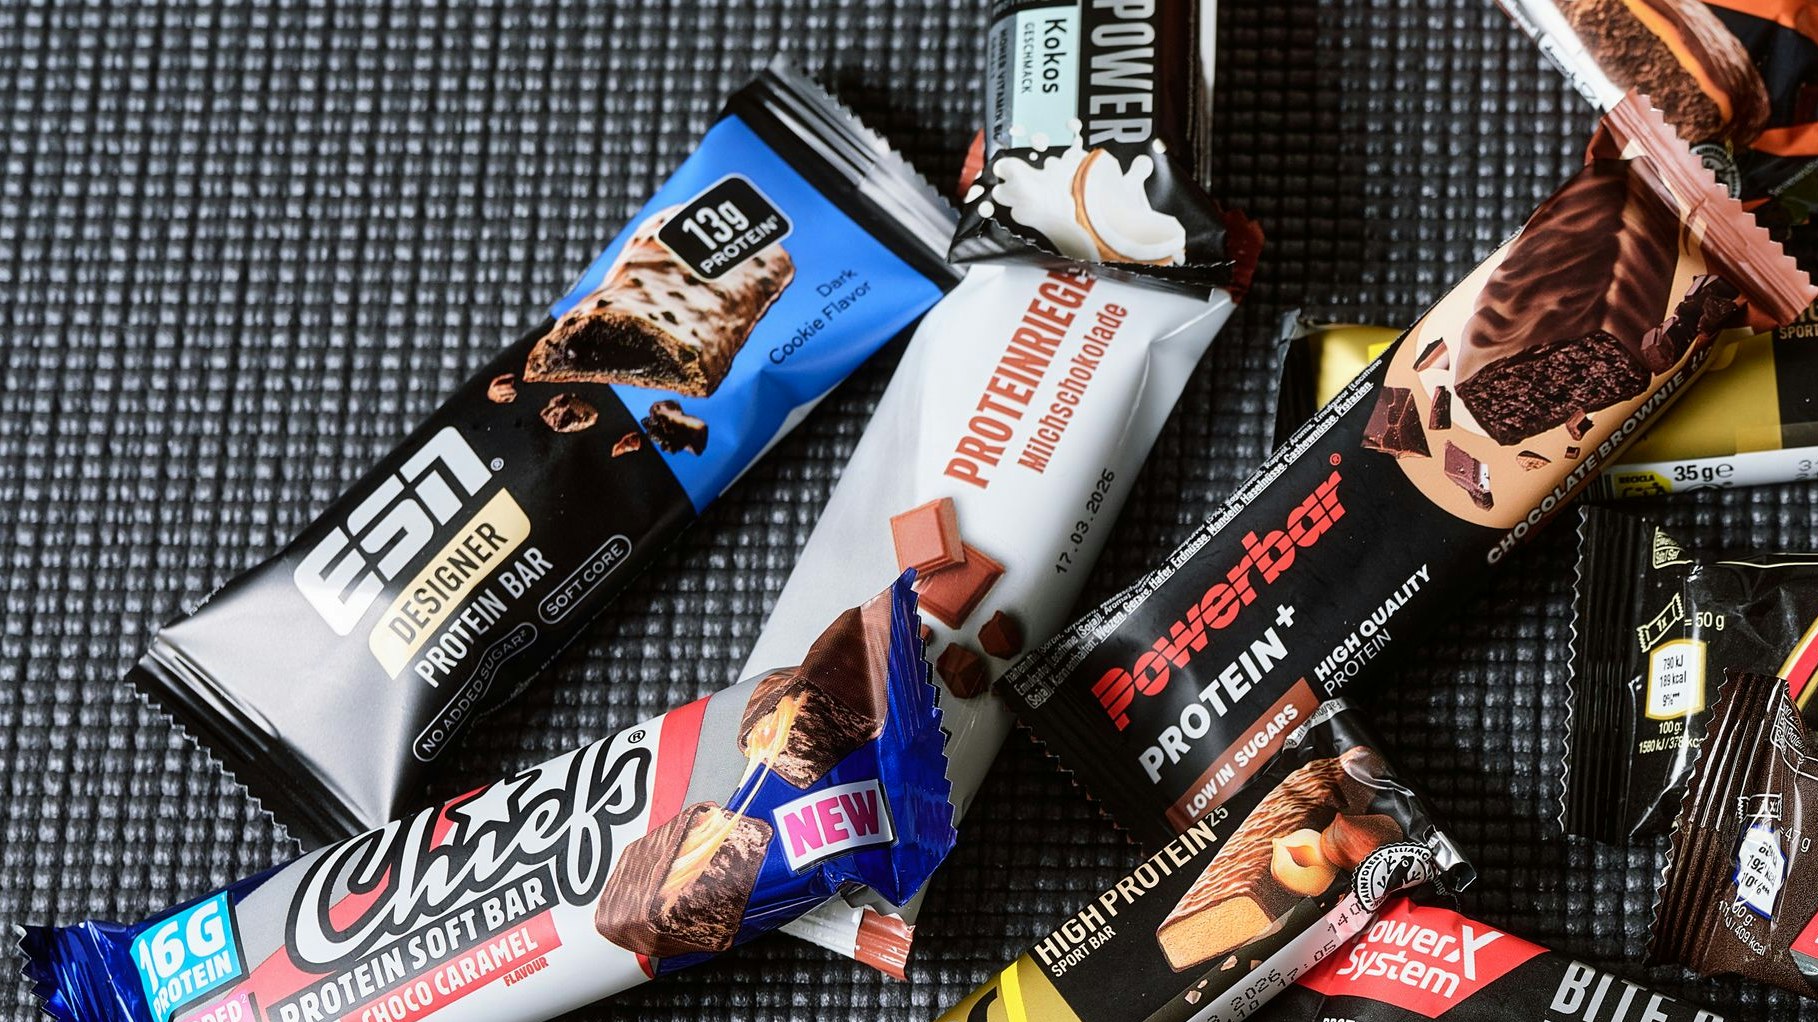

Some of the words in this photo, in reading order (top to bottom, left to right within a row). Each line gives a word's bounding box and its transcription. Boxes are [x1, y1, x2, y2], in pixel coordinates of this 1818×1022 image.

[1020, 22, 1034, 93] GESCHMACK
[1042, 19, 1066, 94] Kokos
[678, 197, 751, 251] 13g
[815, 265, 857, 298] Dark
[821, 281, 872, 321] Flavor
[1017, 298, 1128, 475] Milchschokolade
[1595, 370, 1689, 459] BROWNIE
[389, 518, 509, 645] DESIGNER
[545, 578, 585, 616] SOFT
[581, 543, 624, 583] CORE
[1093, 608, 1127, 642] Weizen,
[1148, 564, 1176, 590] Hafer,
[413, 587, 508, 689] PROTEIN
[498, 544, 554, 598] BAR
[1311, 627, 1368, 684] HIGH
[1358, 562, 1434, 641] QUALITY
[1321, 627, 1393, 698] PROTEIN
[1672, 671, 1686, 684] kcal
[1230, 700, 1300, 772] SUGARS
[1659, 722, 1673, 733] 100
[779, 786, 883, 858] NEW
[1360, 852, 1385, 906] RAINFOREST
[403, 907, 485, 968] SOFT
[479, 876, 549, 931] BAR
[1033, 902, 1106, 968] HIGH
[1049, 942, 1094, 979] SPORT
[1088, 924, 1118, 950] BAR
[149, 950, 232, 1022] PROTEIN
[438, 925, 540, 995] CARAMEL
[503, 954, 550, 988] FLAVOUR
[1336, 943, 1460, 998] System
